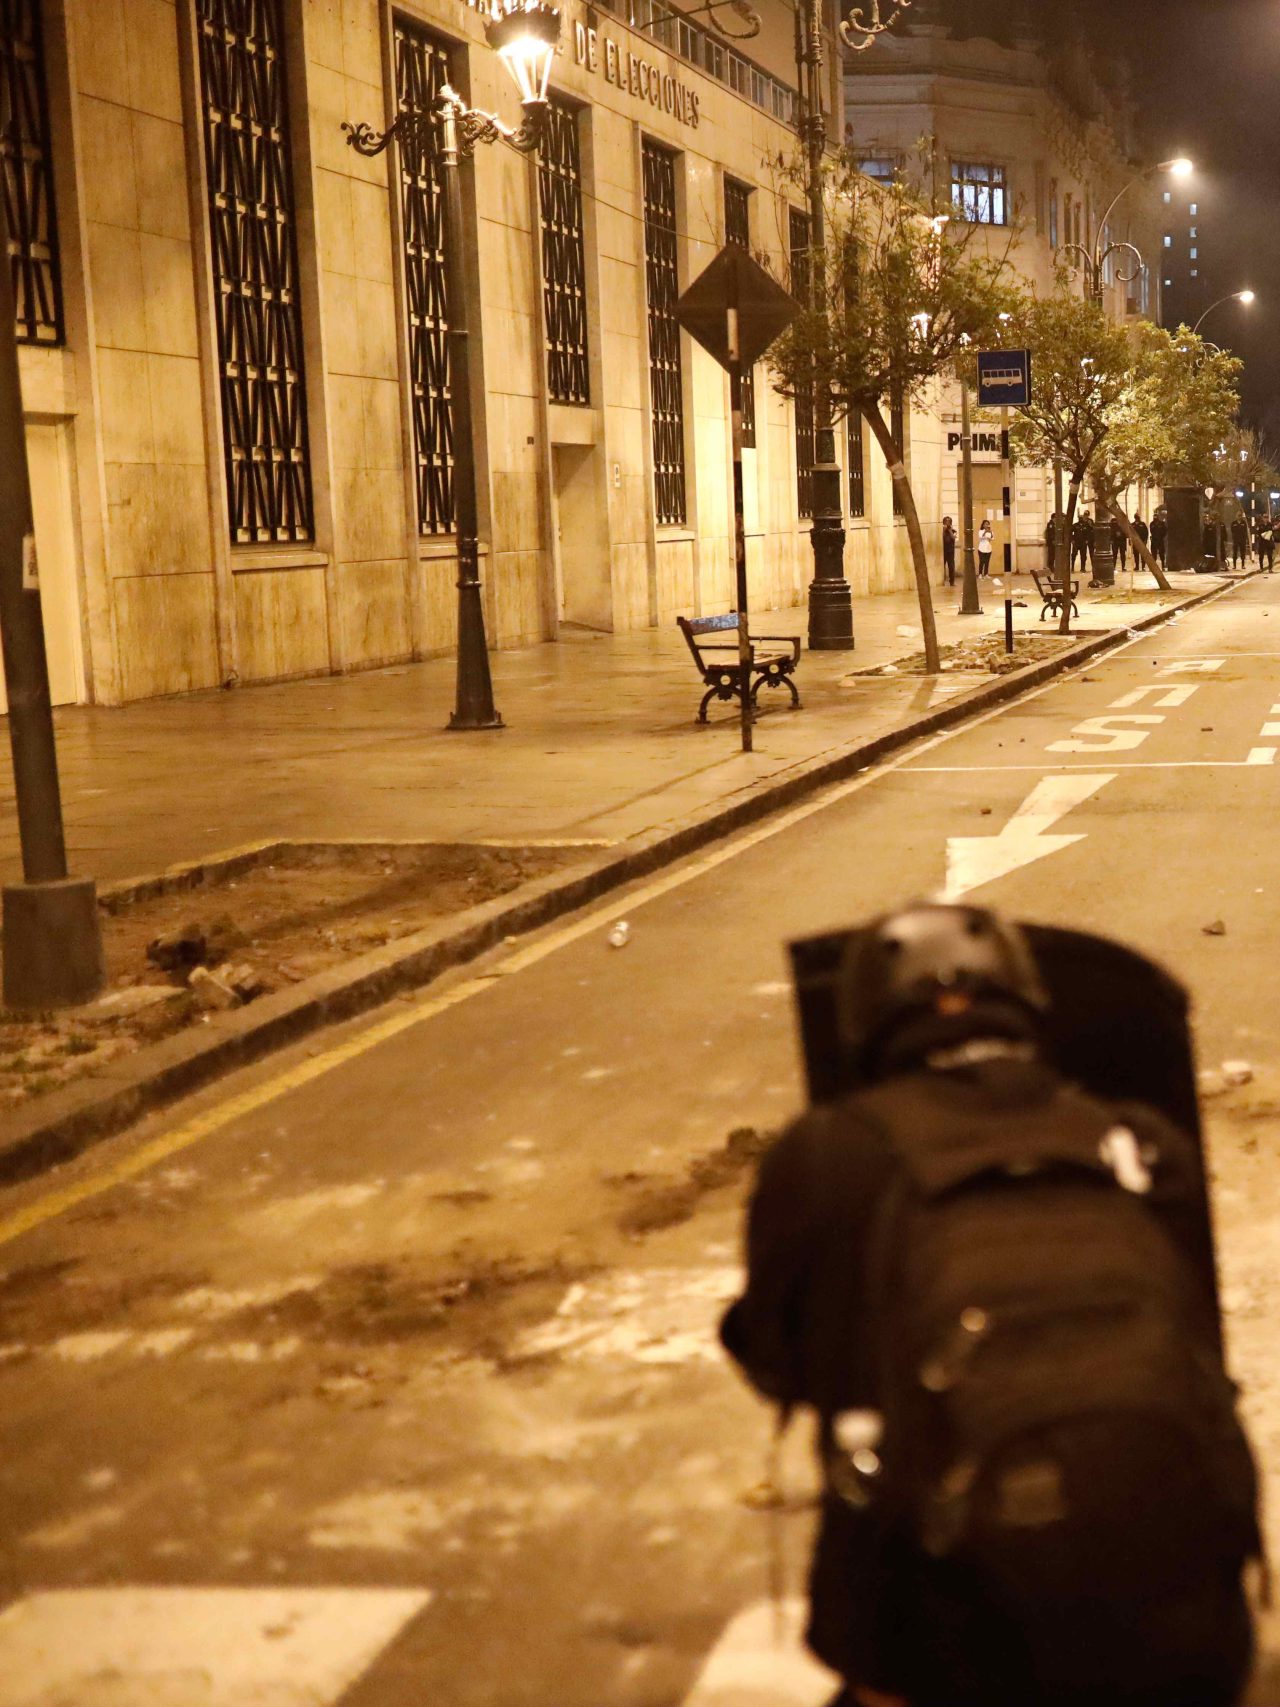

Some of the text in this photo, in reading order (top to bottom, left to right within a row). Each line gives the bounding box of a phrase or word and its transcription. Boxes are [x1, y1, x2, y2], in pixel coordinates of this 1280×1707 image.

[573, 19, 598, 73] DE
[604, 37, 700, 129] ELECCIONES
[947, 432, 1002, 451] PIM
